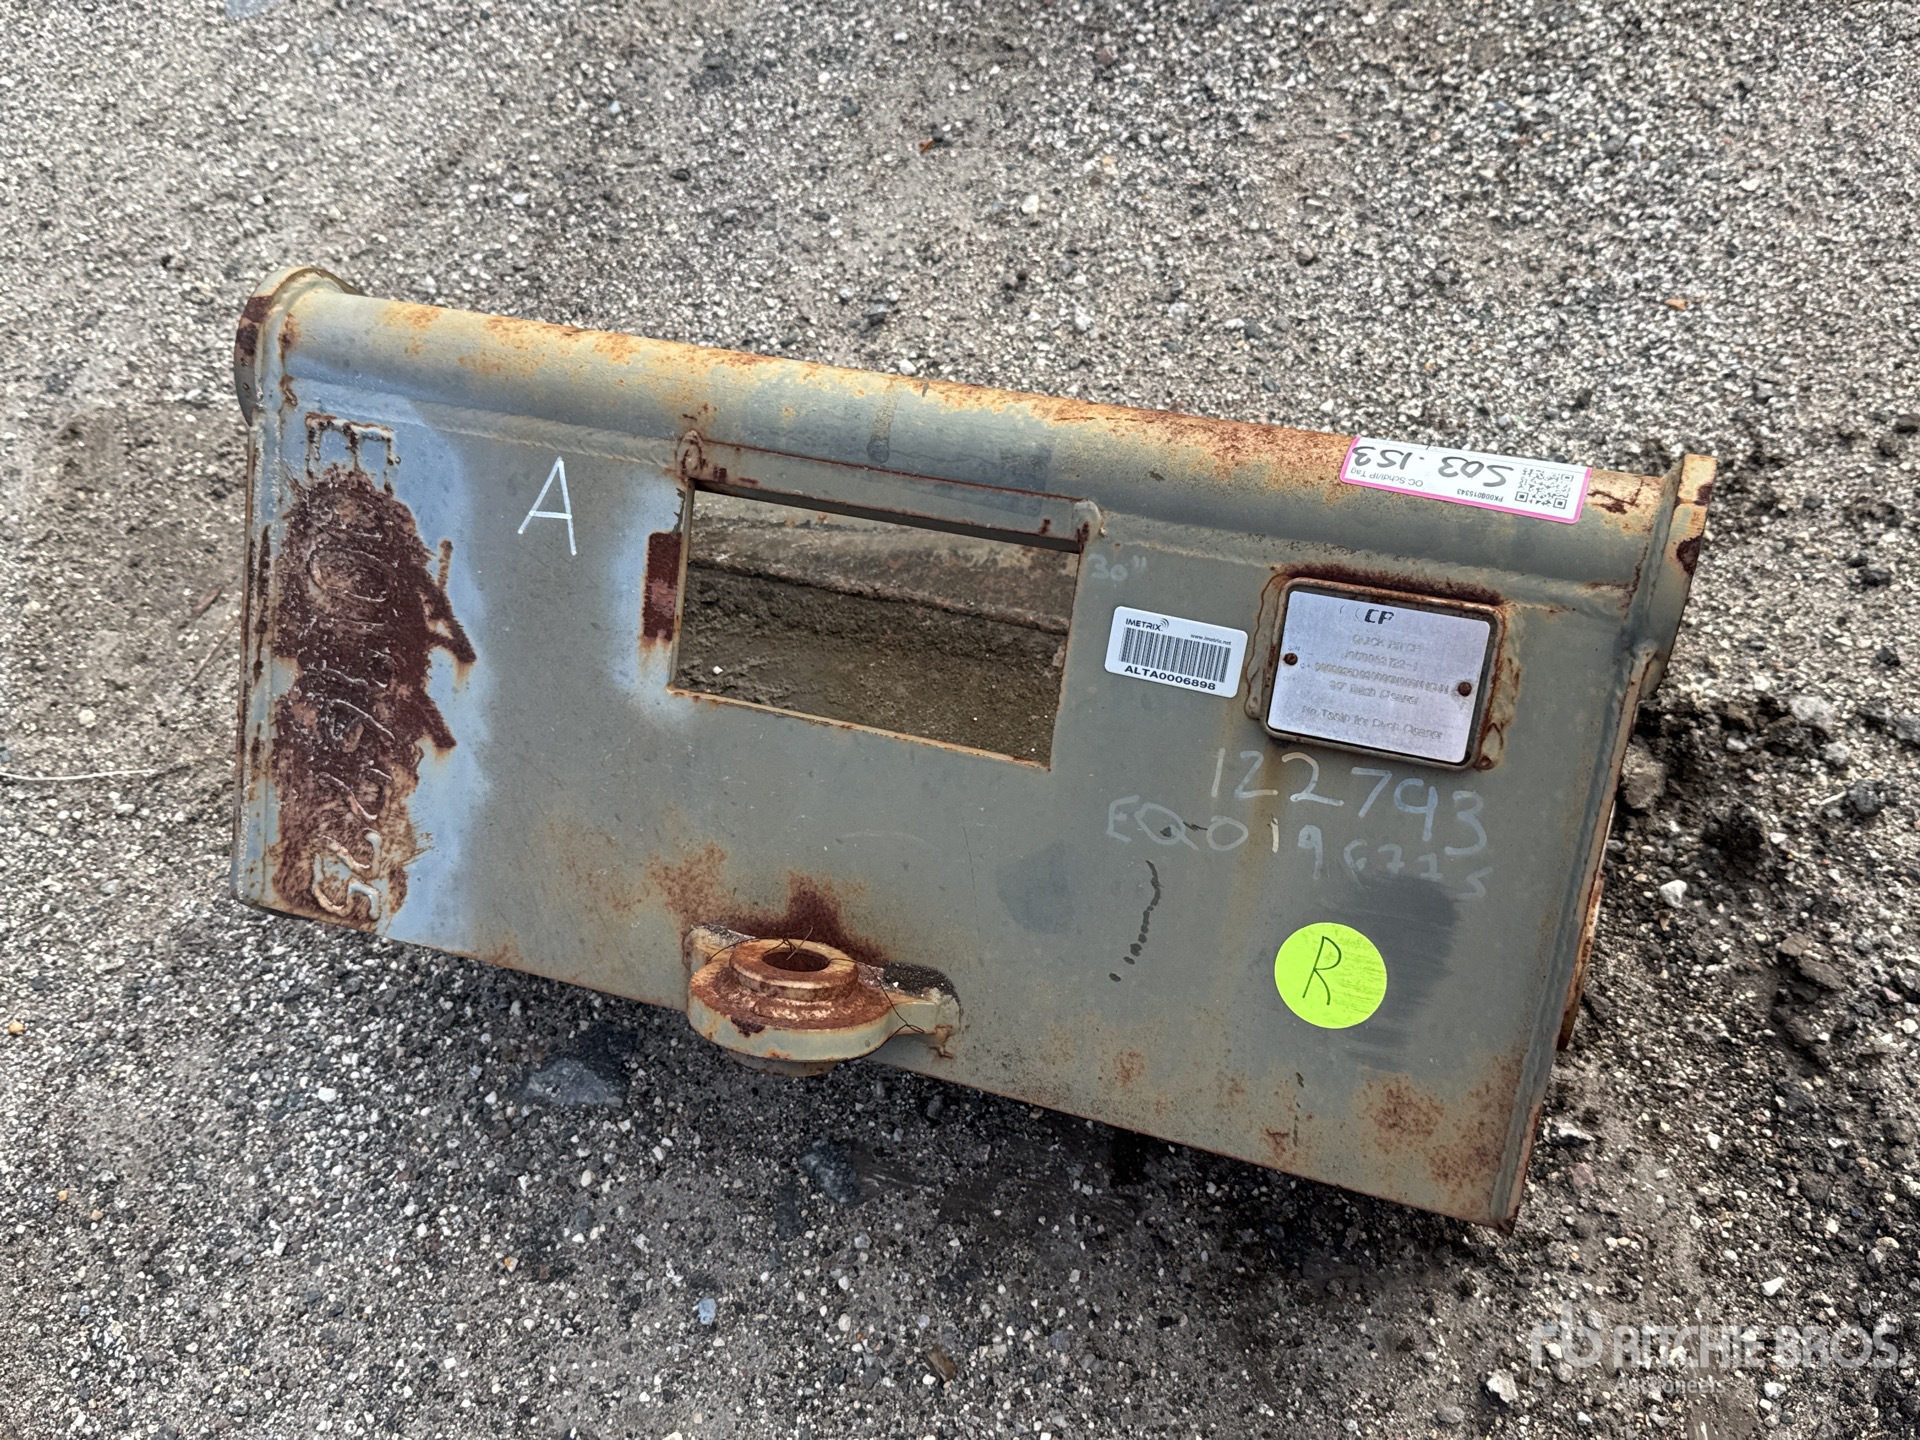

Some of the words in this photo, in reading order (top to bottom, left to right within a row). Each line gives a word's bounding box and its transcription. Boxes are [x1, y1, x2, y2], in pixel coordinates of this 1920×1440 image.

[1350, 466, 1367, 476] Tag
[1408, 478, 1424, 488] OC
[517, 456, 577, 556] A
[1087, 553, 1147, 581] 30"
[1125, 618, 1162, 631] IMETRIX
[1190, 633, 1232, 646] www.imetrix.net
[1352, 634, 1385, 648] QUICK
[1124, 665, 1216, 691] ALTA0006898
[1302, 935, 1342, 1006] R
